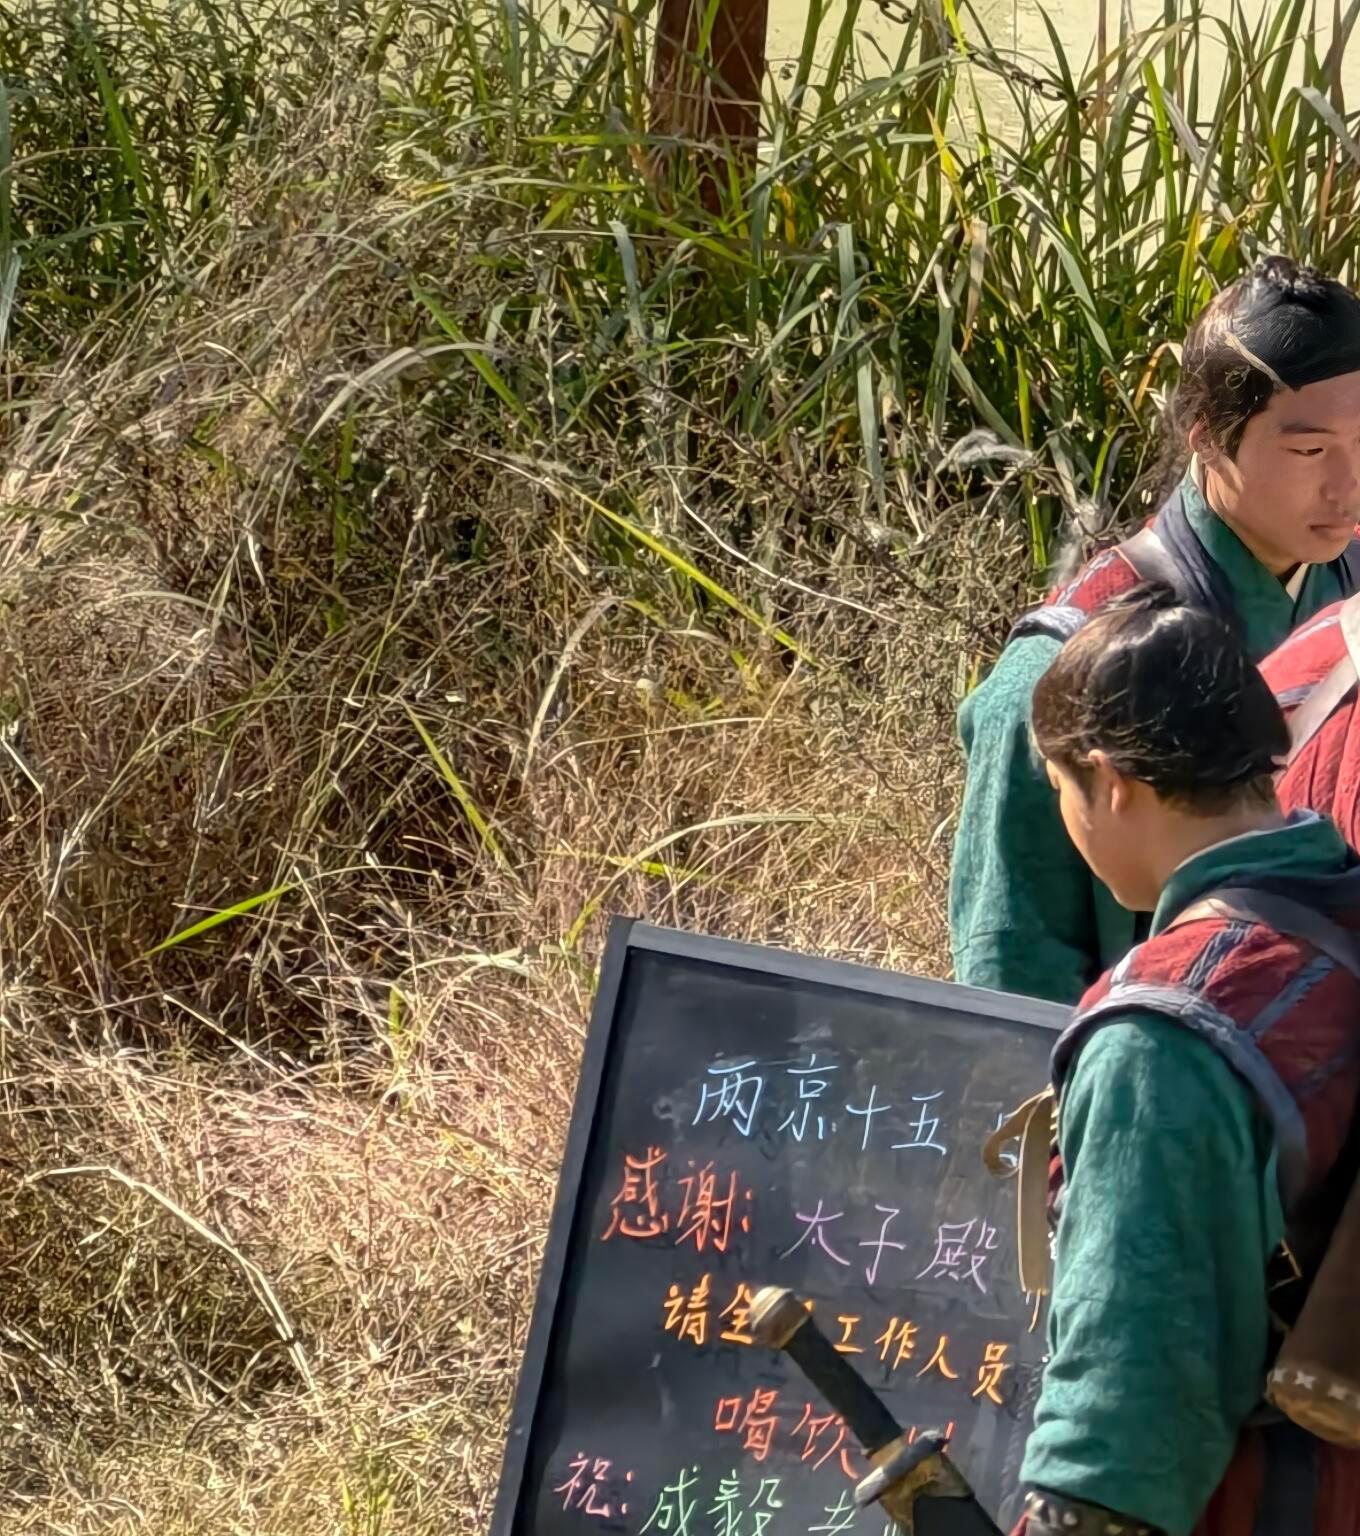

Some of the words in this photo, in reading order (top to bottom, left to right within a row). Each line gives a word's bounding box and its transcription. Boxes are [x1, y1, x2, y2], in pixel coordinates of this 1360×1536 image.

[692, 1053, 1019, 1166] 两京十五
[662, 1272, 1010, 1405] 请全工作人员
